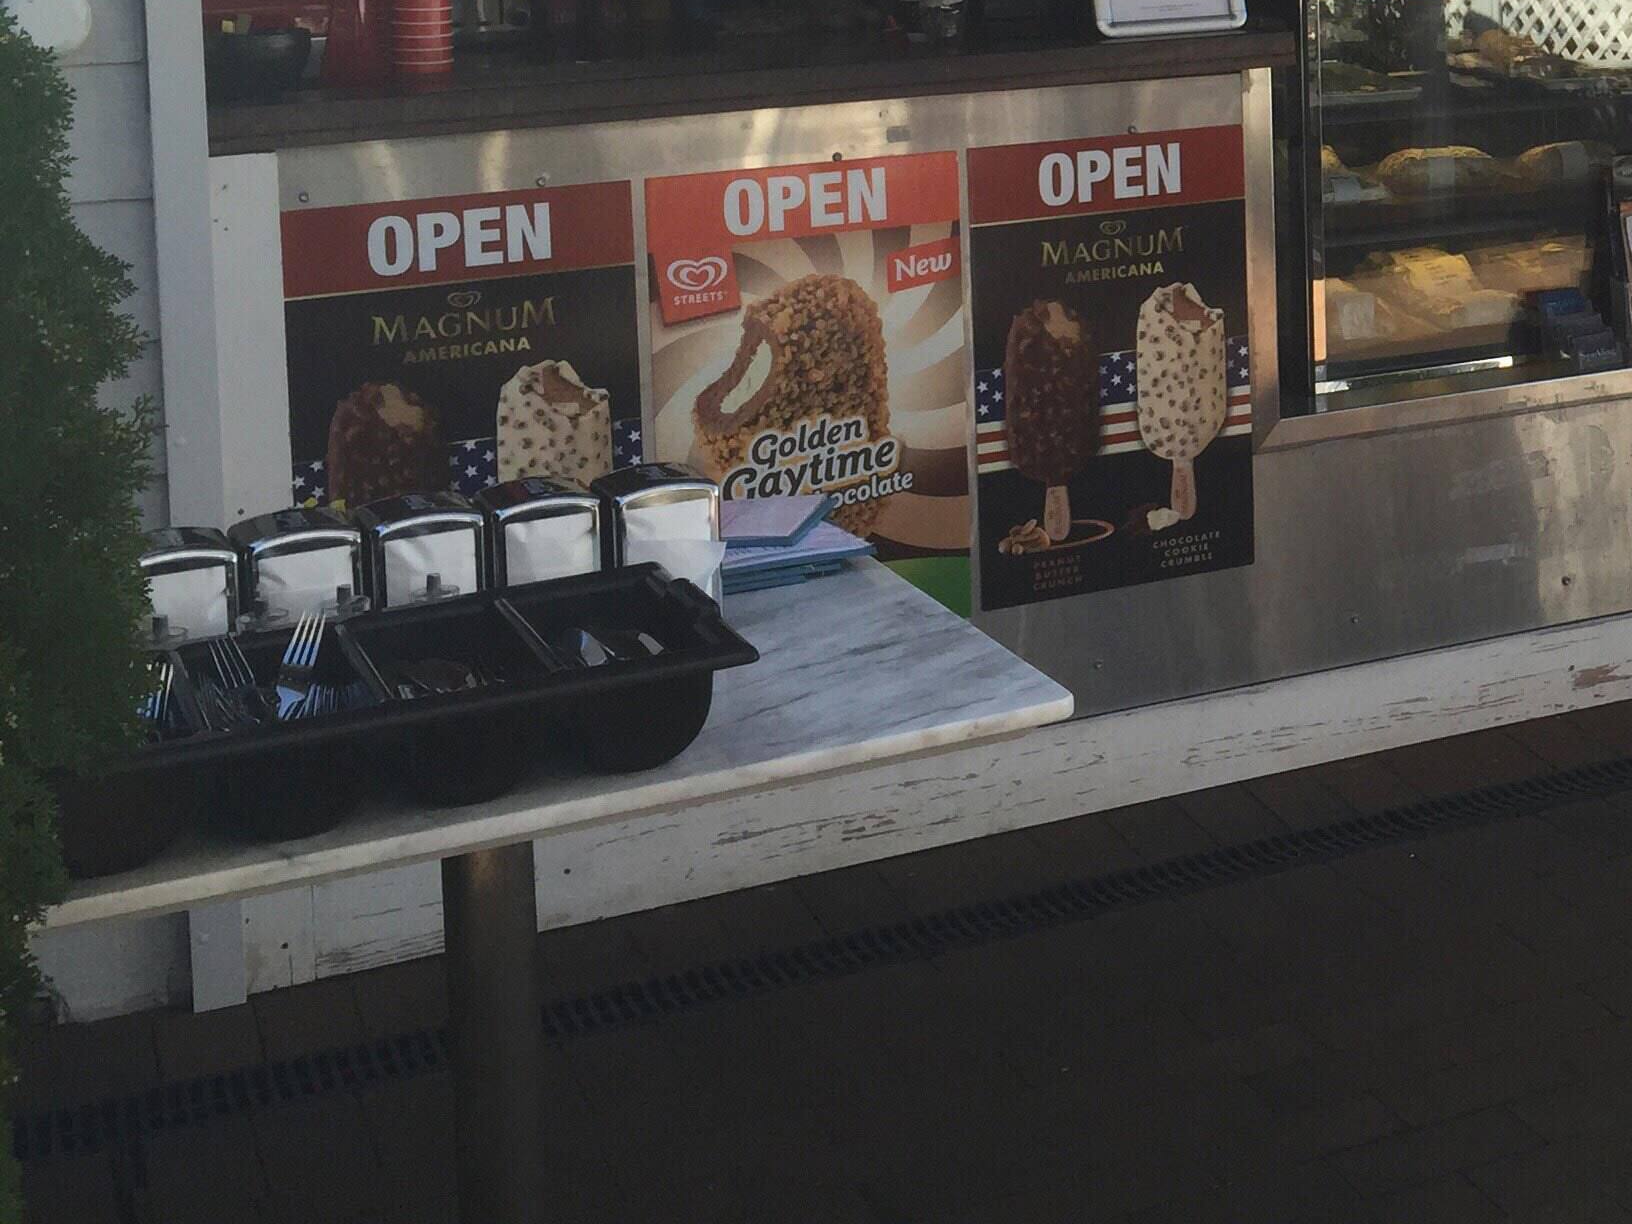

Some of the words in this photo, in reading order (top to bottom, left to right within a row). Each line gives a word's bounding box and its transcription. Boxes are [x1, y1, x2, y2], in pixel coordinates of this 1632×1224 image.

[1037, 142, 1182, 207] OPEN
[722, 167, 888, 236] OPEN
[366, 201, 552, 276] OPEN
[1041, 226, 1186, 268] MAGNUM
[893, 249, 951, 282] New
[1064, 260, 1165, 284] AMERICANA
[673, 291, 724, 307] STREETS
[371, 295, 557, 347] MAGNUM
[403, 335, 532, 365] AMERICANA
[751, 419, 863, 469] Golden
[721, 439, 897, 501] Gaytime
[1152, 530, 1221, 550] CHOCOLATE
[1164, 542, 1209, 557] COOKIE
[1033, 554, 1081, 569] PEANUT
[1034, 565, 1080, 580] BUTTER
[1160, 552, 1213, 568] CRUMBLE
[1033, 575, 1083, 591] CRUNCH
